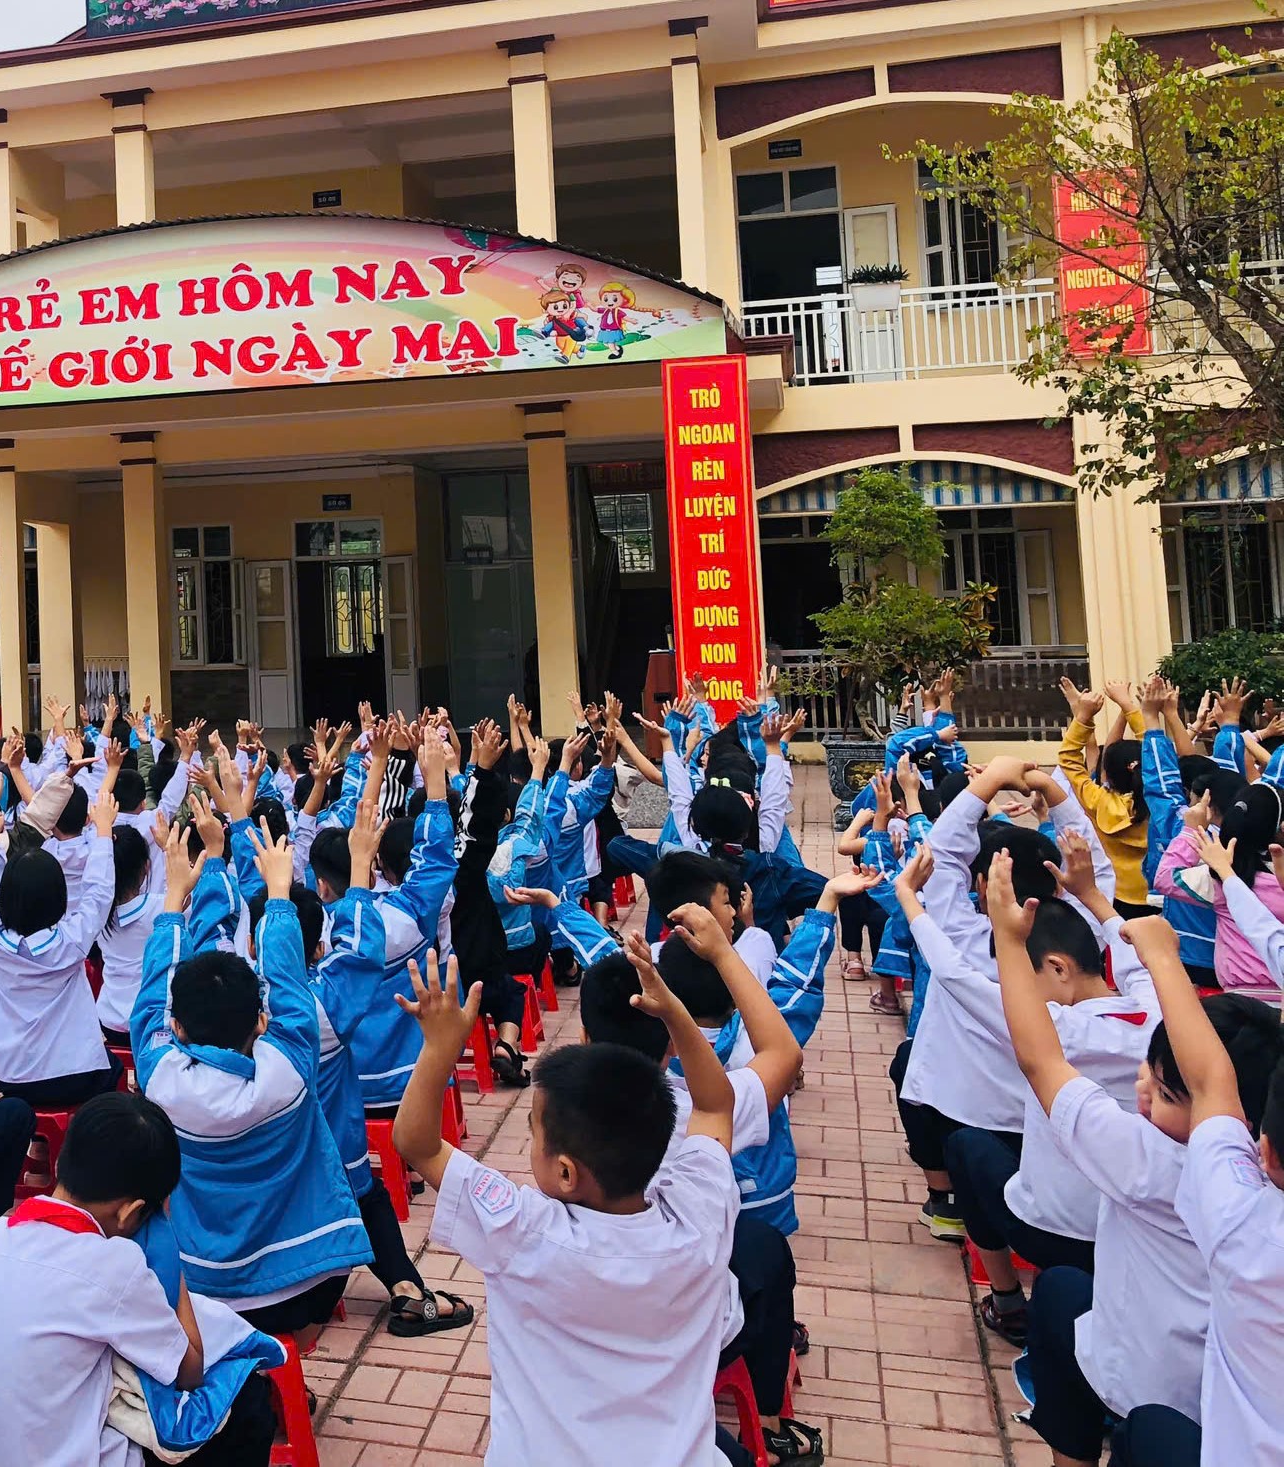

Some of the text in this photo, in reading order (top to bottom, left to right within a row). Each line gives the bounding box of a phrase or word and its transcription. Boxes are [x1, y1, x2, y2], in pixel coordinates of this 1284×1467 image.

[78, 283, 161, 326] EM
[178, 263, 315, 316] HÔM
[332, 255, 476, 303] NAY
[48, 335, 173, 389] GIỚI
[190, 322, 372, 378] NGÀY
[392, 317, 520, 364] MAI
[689, 382, 721, 409] TRÒ
[678, 423, 735, 446] NGOAN
[692, 456, 725, 481] RÈN
[684, 492, 736, 522] LUYỆN
[699, 529, 725, 554] TRÍ
[697, 566, 731, 591] ĐỨC
[693, 605, 740, 632] DỰNG
[700, 643, 737, 664] NON
